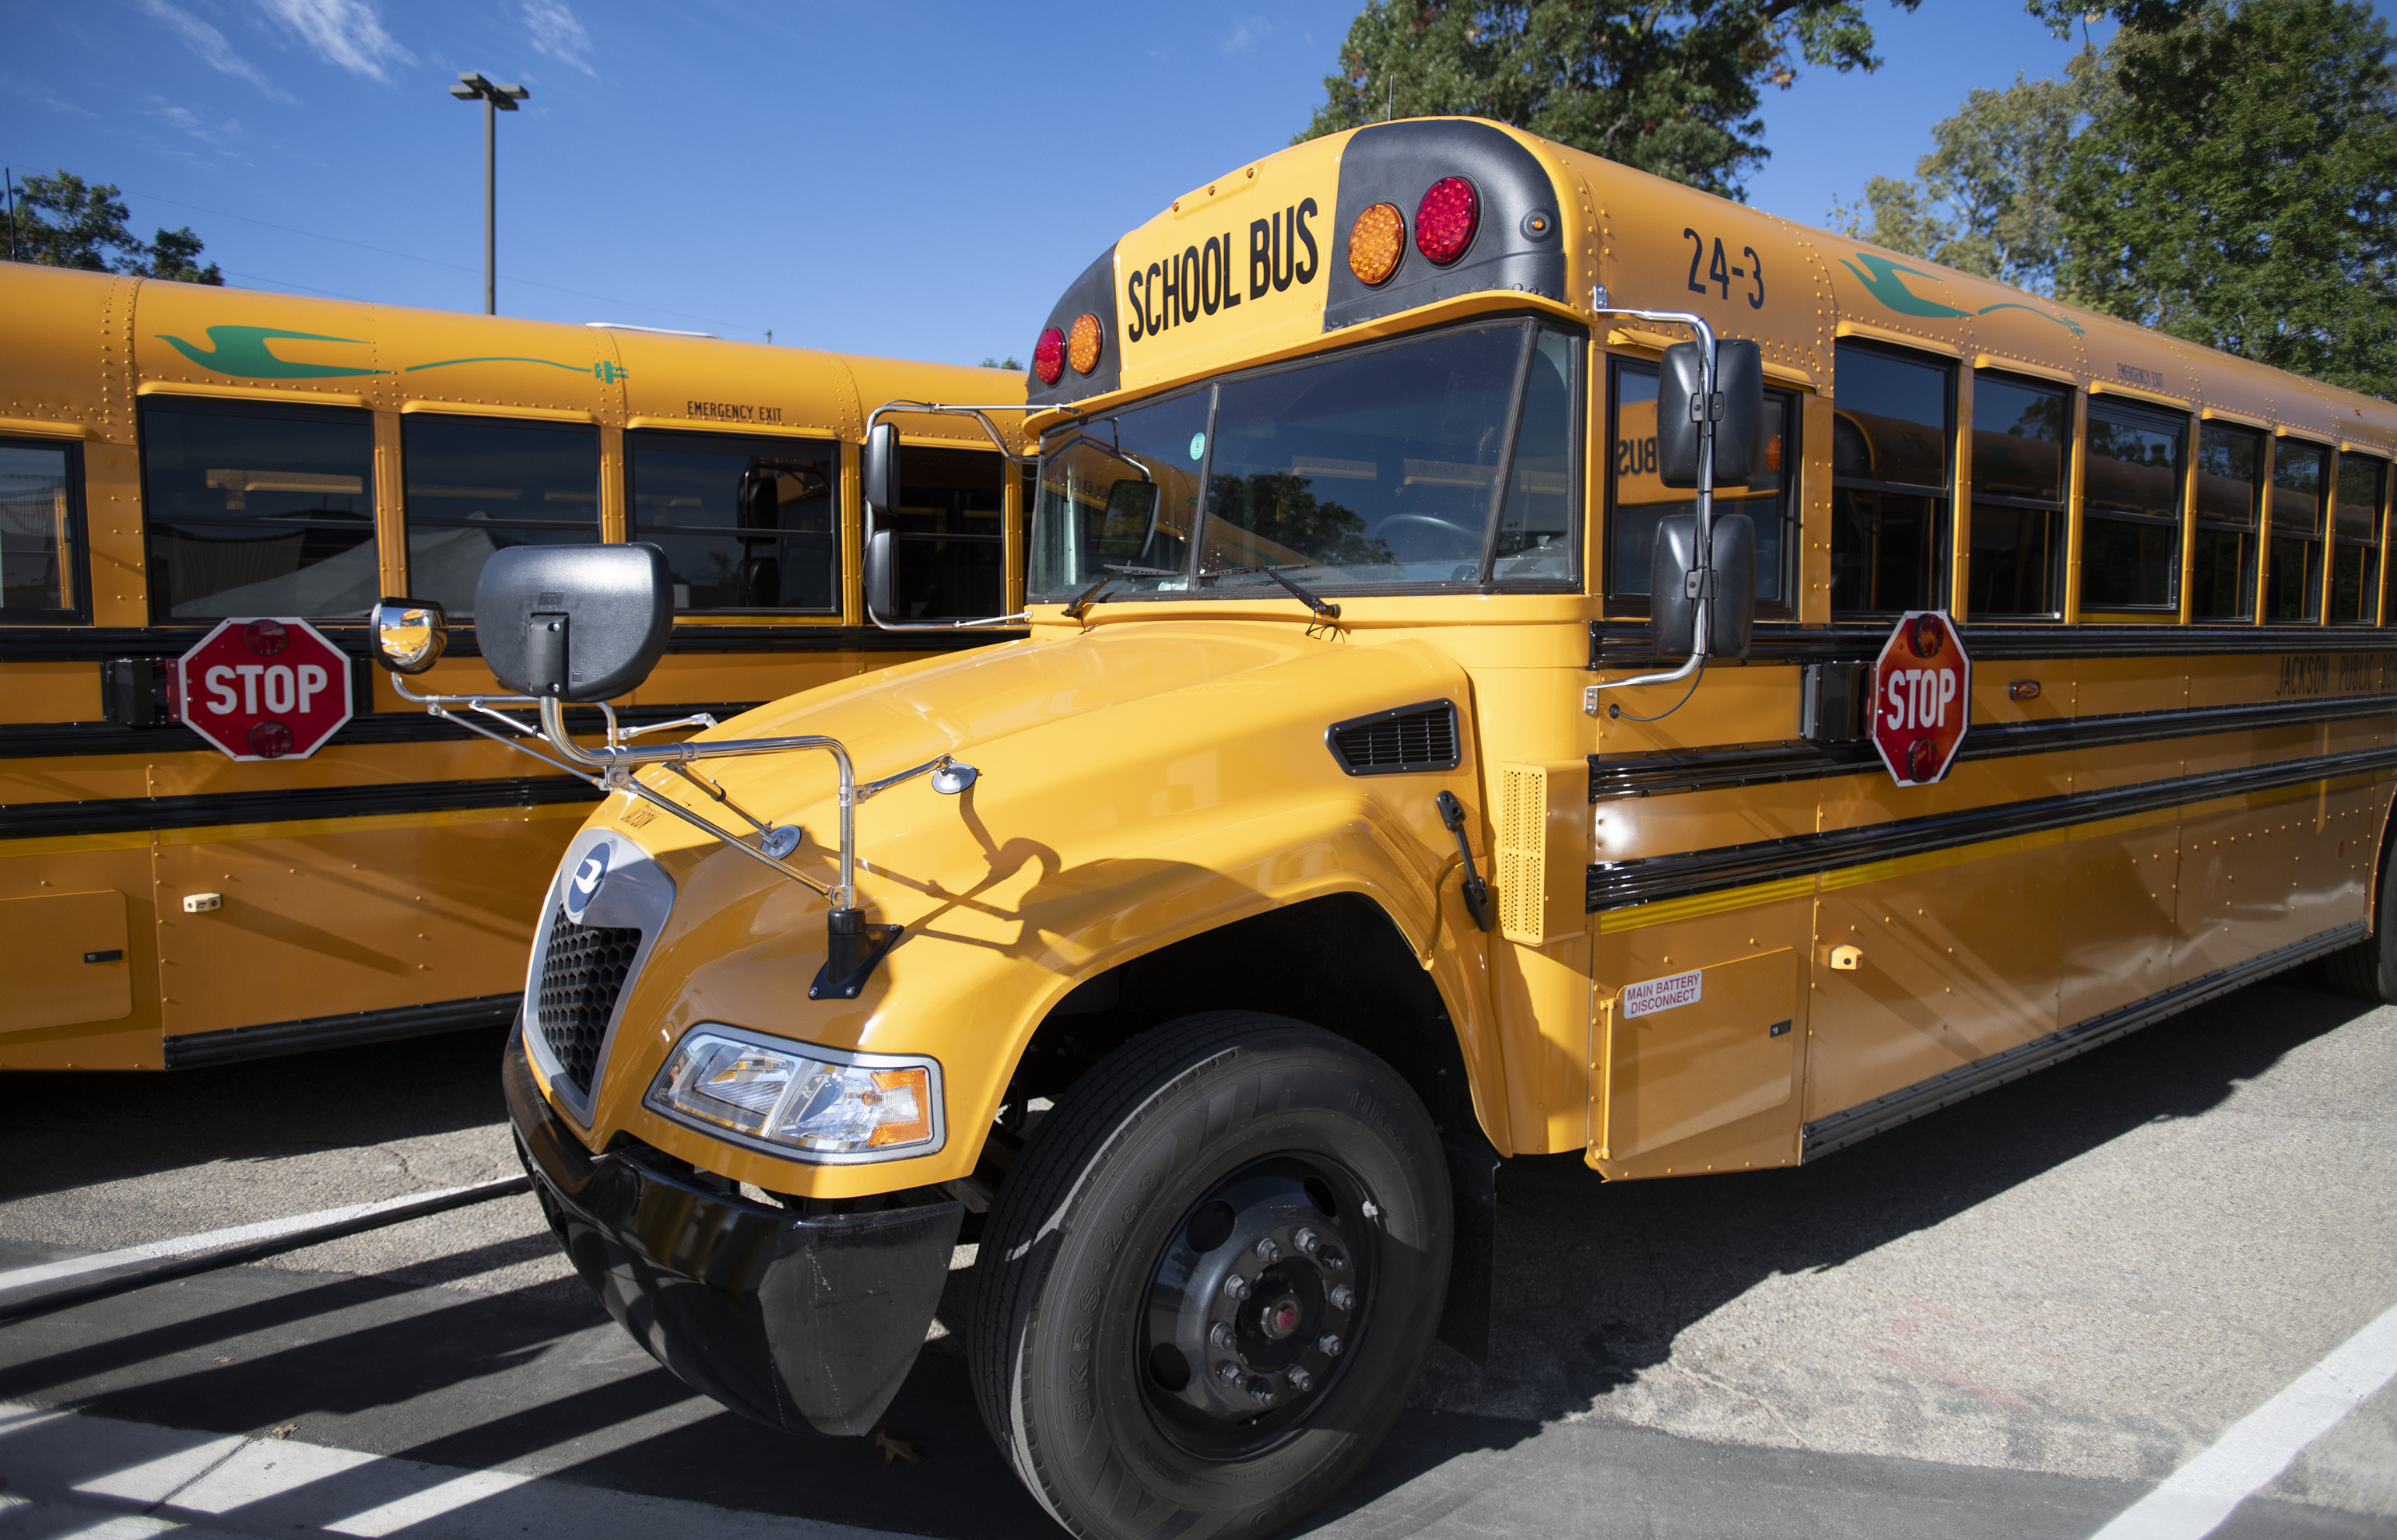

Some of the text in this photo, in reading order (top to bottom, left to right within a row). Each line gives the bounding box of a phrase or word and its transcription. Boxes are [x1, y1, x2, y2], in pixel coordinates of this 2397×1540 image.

[1128, 198, 1318, 342] SCHOOL BUS
[1683, 227, 1764, 310] 24-3
[2117, 363, 2164, 388] EMERGENCY EXIT
[687, 401, 782, 422] EMERGENCY EXIT
[205, 665, 328, 714] STOP
[2276, 655, 2329, 696] JACKSON
[2339, 654, 2374, 692] PUBLIC
[1886, 668, 1956, 731] STOP
[1627, 973, 1700, 1001] MAIN BATTERY
[1631, 988, 1696, 1014] DISCONNECT
